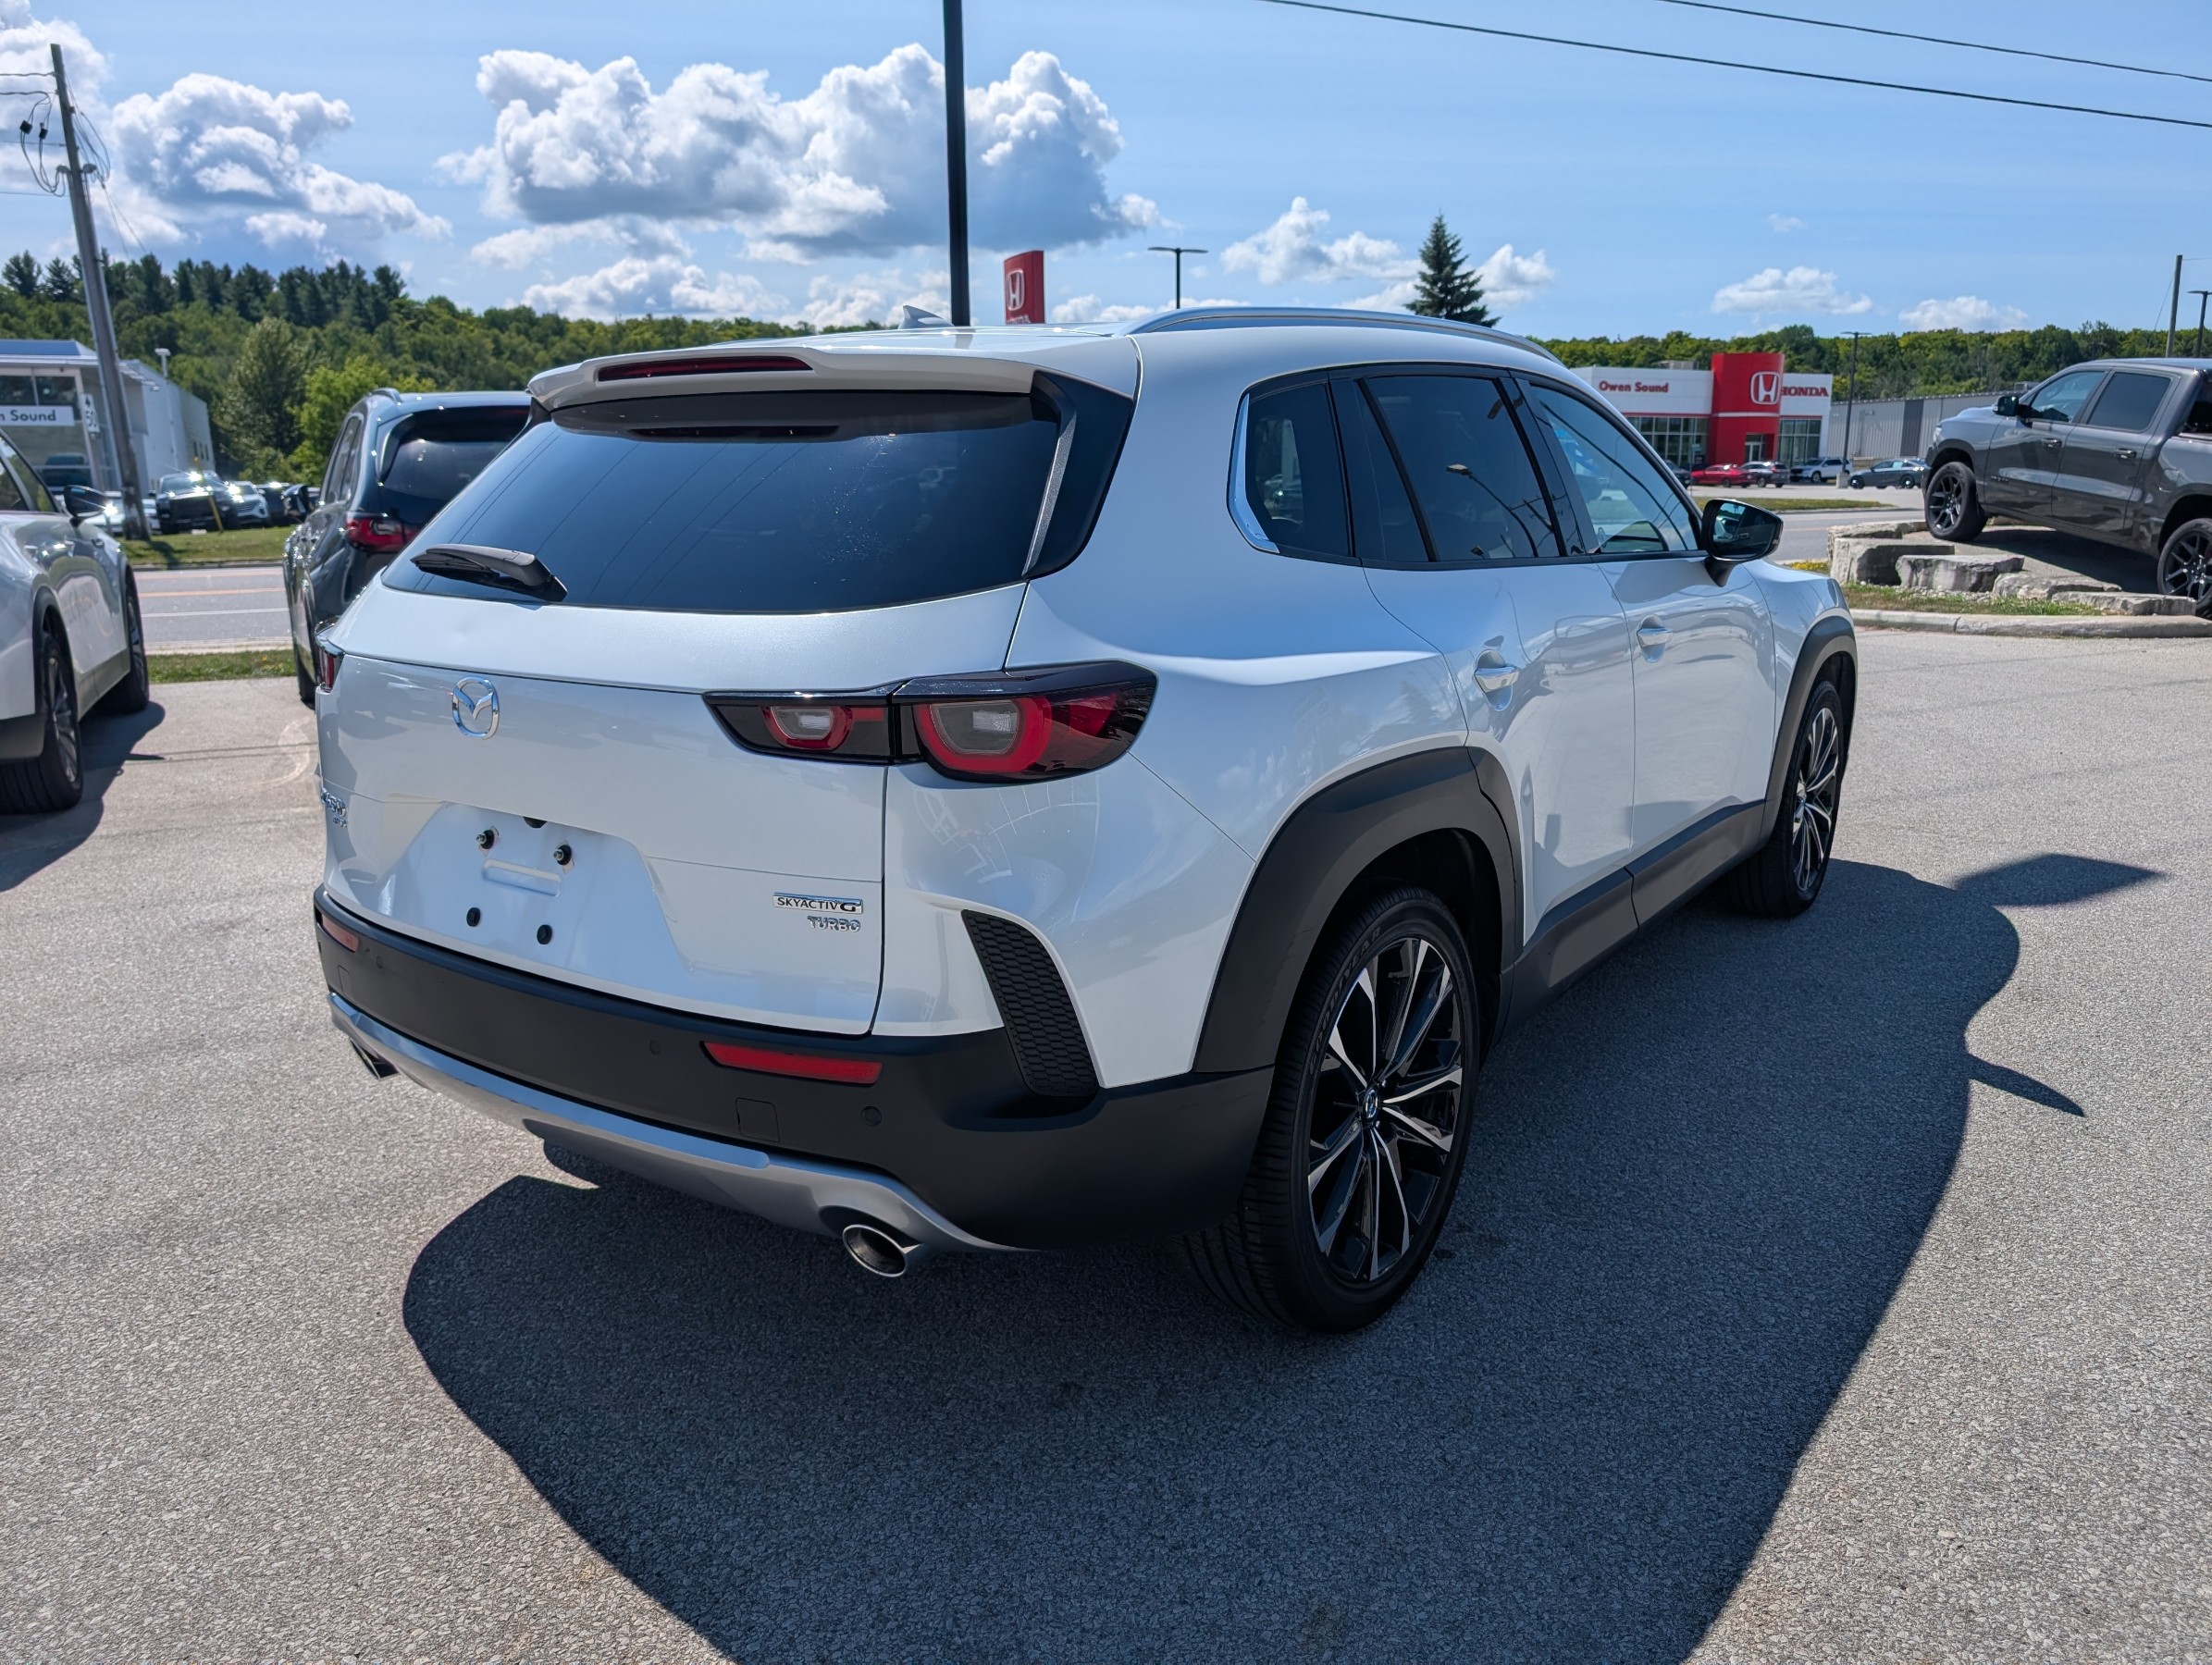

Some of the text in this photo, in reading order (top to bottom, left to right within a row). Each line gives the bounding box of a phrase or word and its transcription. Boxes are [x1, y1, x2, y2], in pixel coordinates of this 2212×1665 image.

[1599, 380, 1669, 393] Owen Sound
[10, 409, 56, 422] Sound
[807, 916, 861, 932] TURBO
